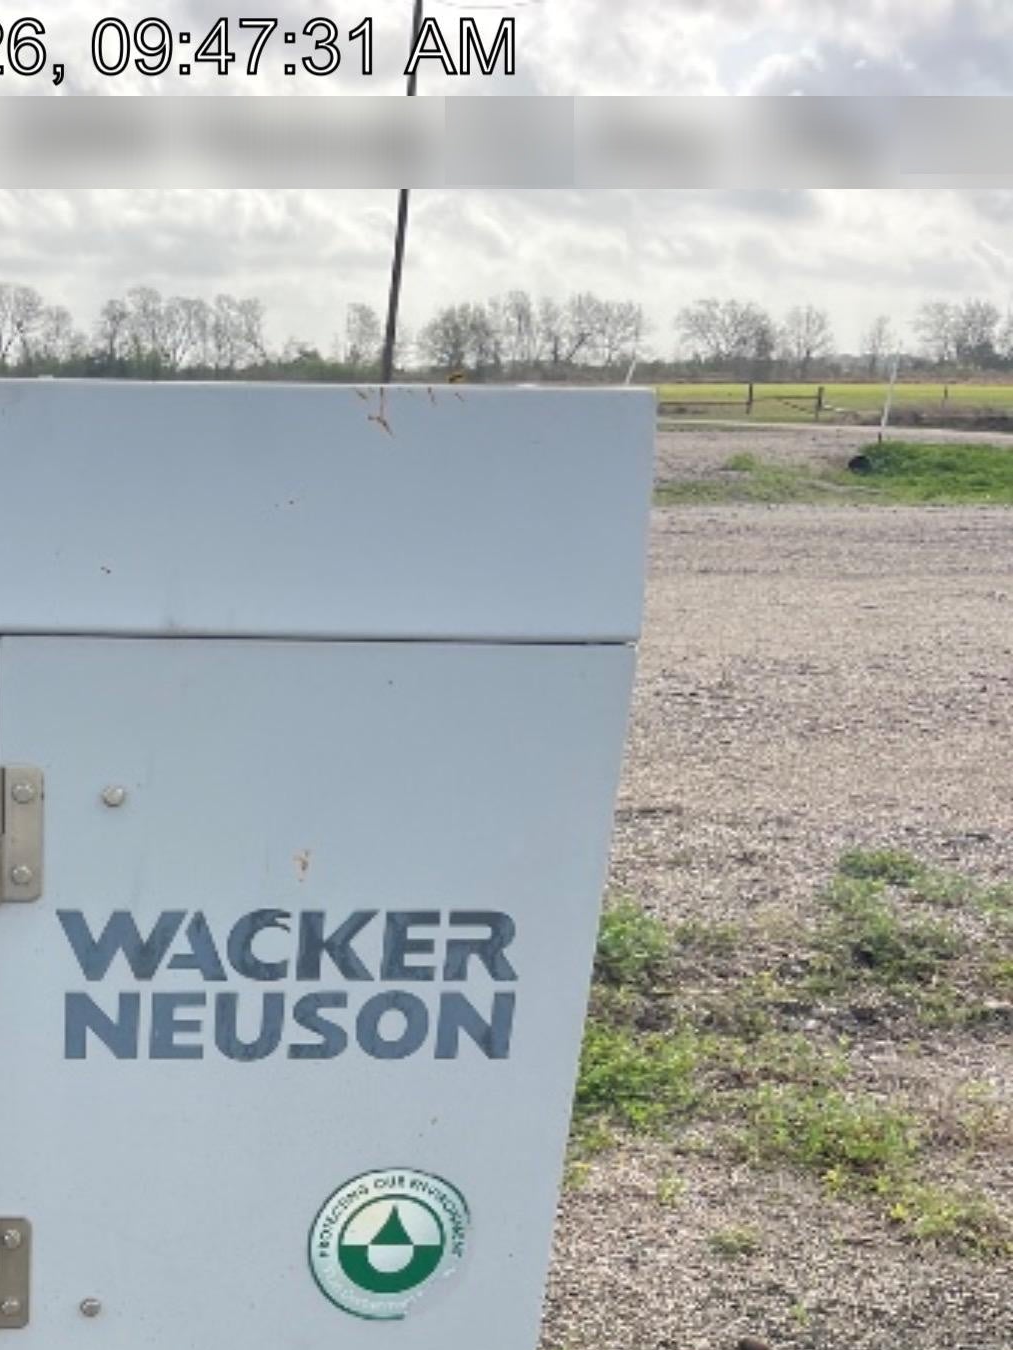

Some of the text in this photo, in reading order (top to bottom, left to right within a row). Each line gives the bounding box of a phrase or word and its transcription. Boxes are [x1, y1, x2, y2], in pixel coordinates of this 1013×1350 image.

[55, 908, 519, 982] WACKER
[64, 989, 516, 1061] NEUSON
[319, 1176, 466, 1259] PROTECTING OUR ENVIRONMENT
